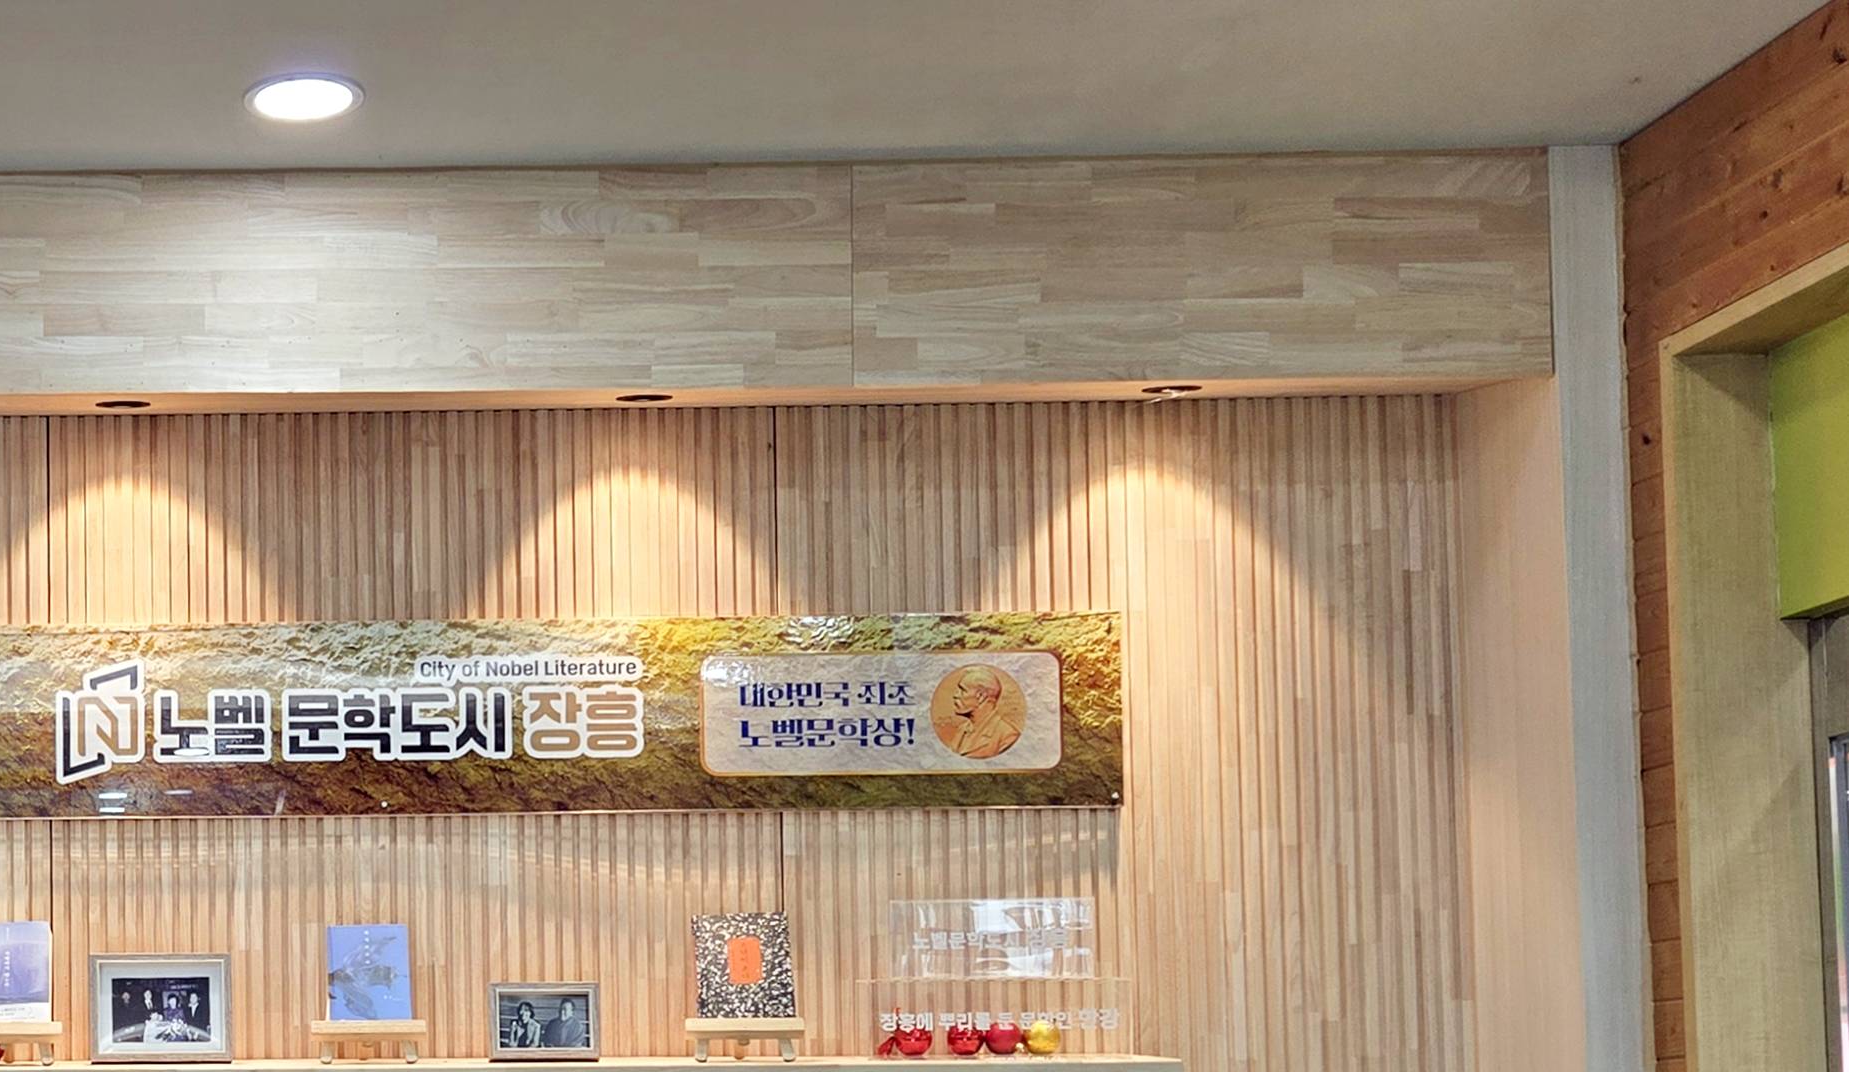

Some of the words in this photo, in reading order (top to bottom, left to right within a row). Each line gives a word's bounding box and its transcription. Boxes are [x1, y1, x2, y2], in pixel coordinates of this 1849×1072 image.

[420, 660, 455, 681] City
[462, 659, 481, 676] of
[485, 659, 540, 677] Nobel
[544, 658, 638, 676] Literature
[739, 681, 850, 709] 대한민국
[857, 680, 916, 708] 최초
[159, 694, 266, 756] 노벨
[288, 691, 506, 755] 문학도시
[529, 687, 638, 753] 장흥
[739, 717, 916, 748] 노벨문학상!
